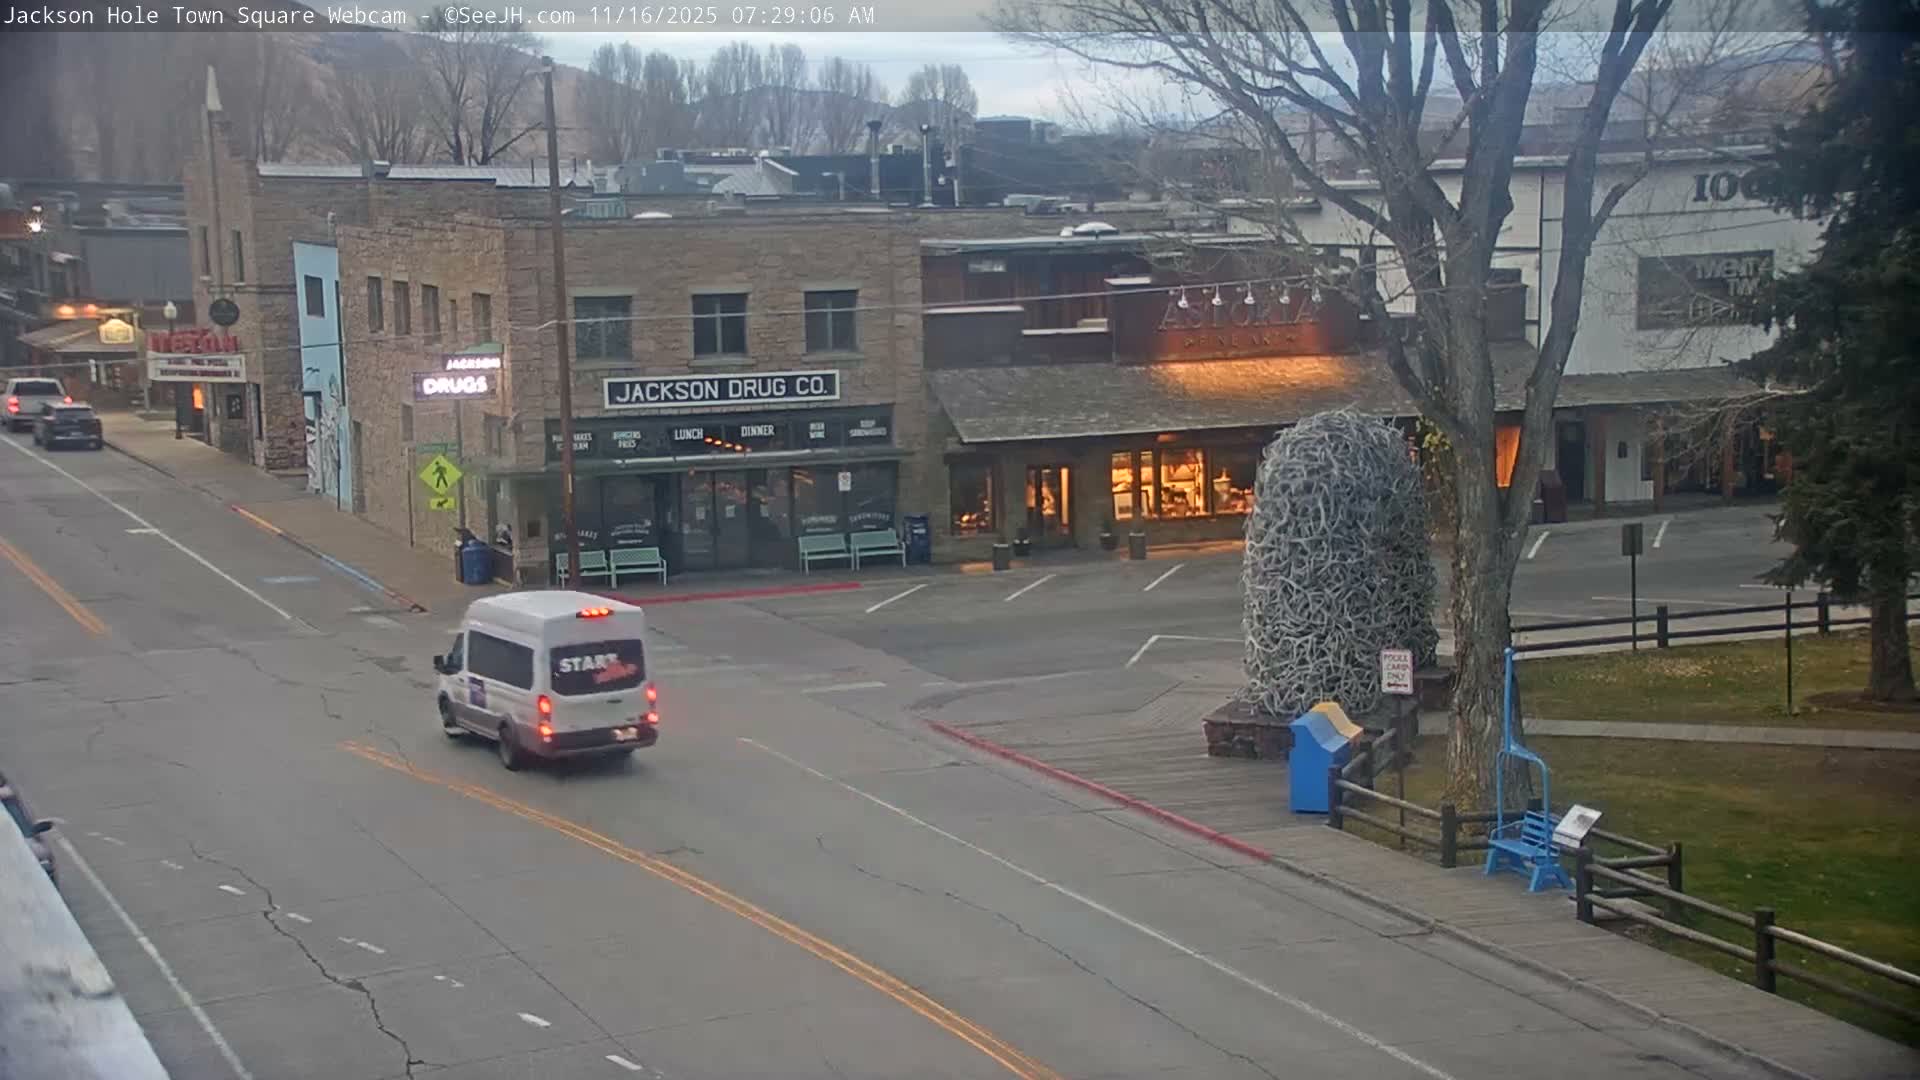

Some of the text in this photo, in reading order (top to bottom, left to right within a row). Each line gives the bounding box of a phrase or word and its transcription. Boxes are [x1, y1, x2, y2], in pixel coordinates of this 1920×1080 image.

[422, 376, 488, 395] DRUGS
[616, 376, 828, 402] JACKSON DRUG CO.
[674, 428, 704, 441] LUNCH
[740, 425, 775, 437] DINNER
[559, 654, 617, 673] START
